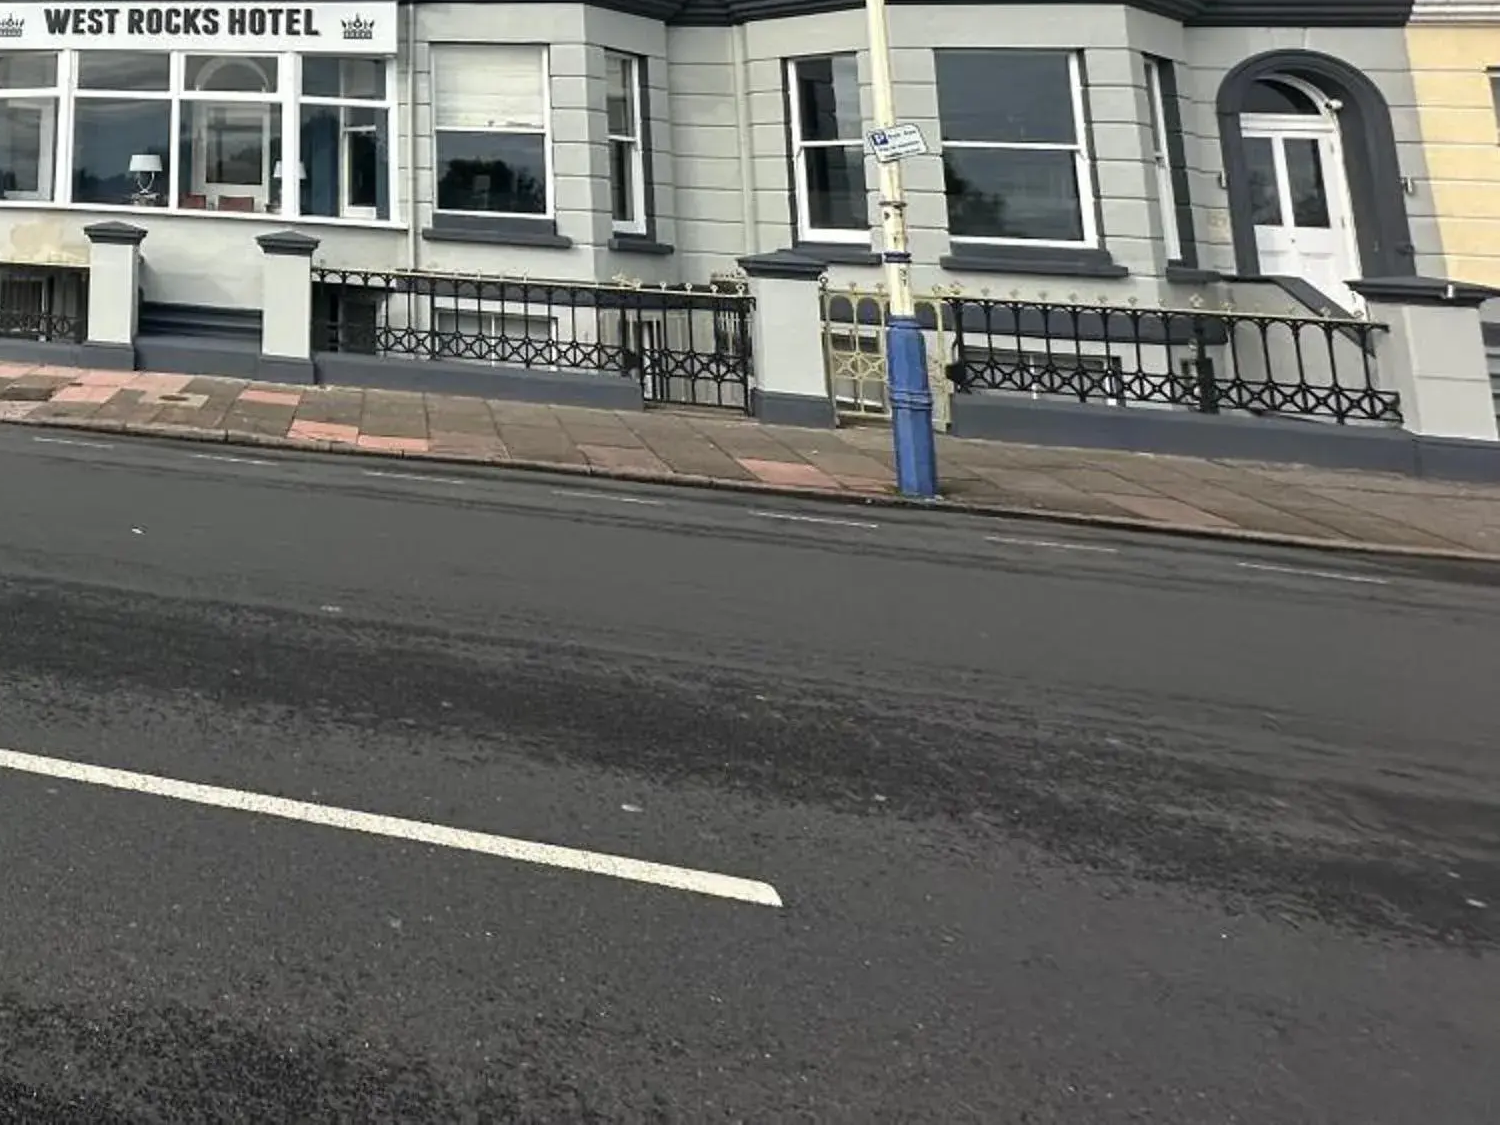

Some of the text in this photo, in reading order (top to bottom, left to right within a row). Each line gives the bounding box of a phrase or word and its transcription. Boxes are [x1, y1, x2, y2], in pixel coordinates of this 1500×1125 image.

[44, 8, 320, 36] WEST ROCKS HOTEL
